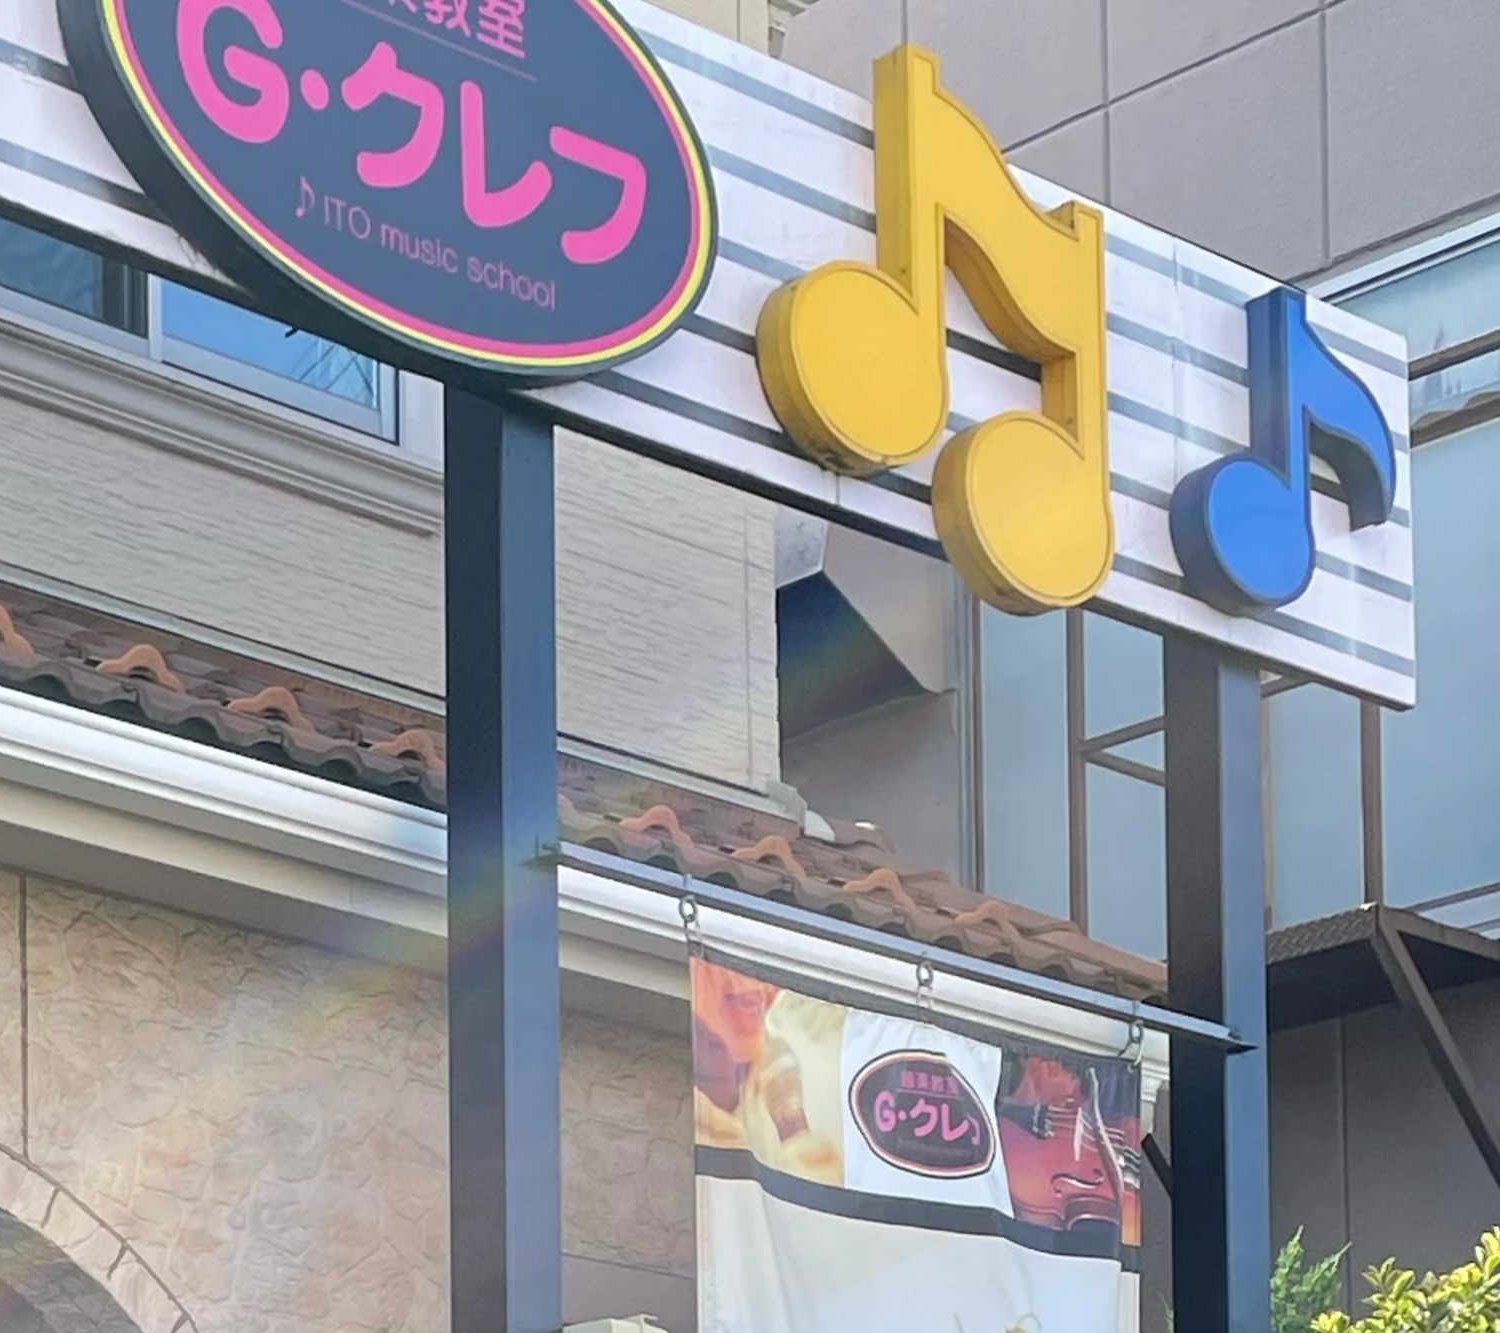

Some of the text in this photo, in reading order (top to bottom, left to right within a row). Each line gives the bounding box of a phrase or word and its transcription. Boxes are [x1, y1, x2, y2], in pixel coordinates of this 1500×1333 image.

[324, 195, 555, 310] ITO music school
